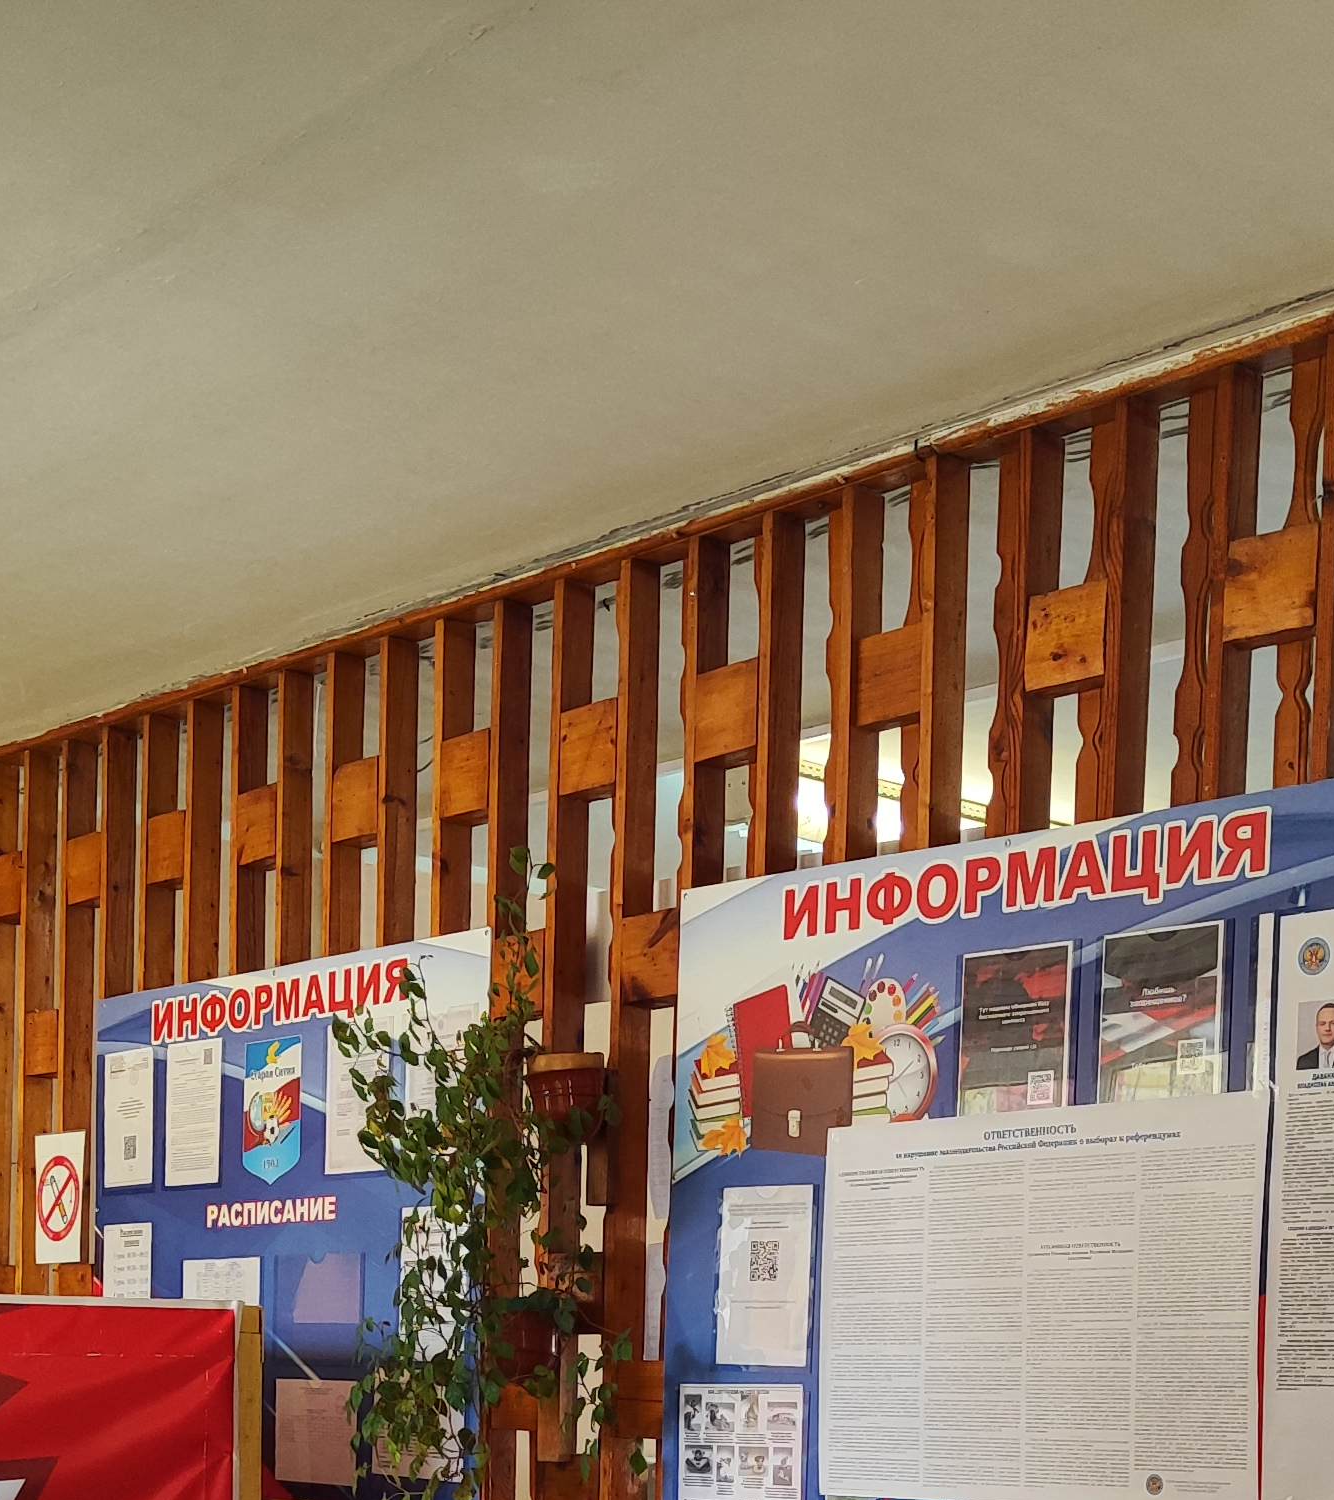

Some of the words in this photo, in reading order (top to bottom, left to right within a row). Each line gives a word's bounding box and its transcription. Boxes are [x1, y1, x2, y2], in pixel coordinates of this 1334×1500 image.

[781, 810, 1270, 942] ИНФОРМАЦИЯ
[152, 958, 410, 1042] ИНФОРМАЦИЯ
[983, 1124, 1076, 1141] ОТВЕТСТВЕННОСТЬ
[207, 1196, 337, 1228] РАСПИСАНИЕ
